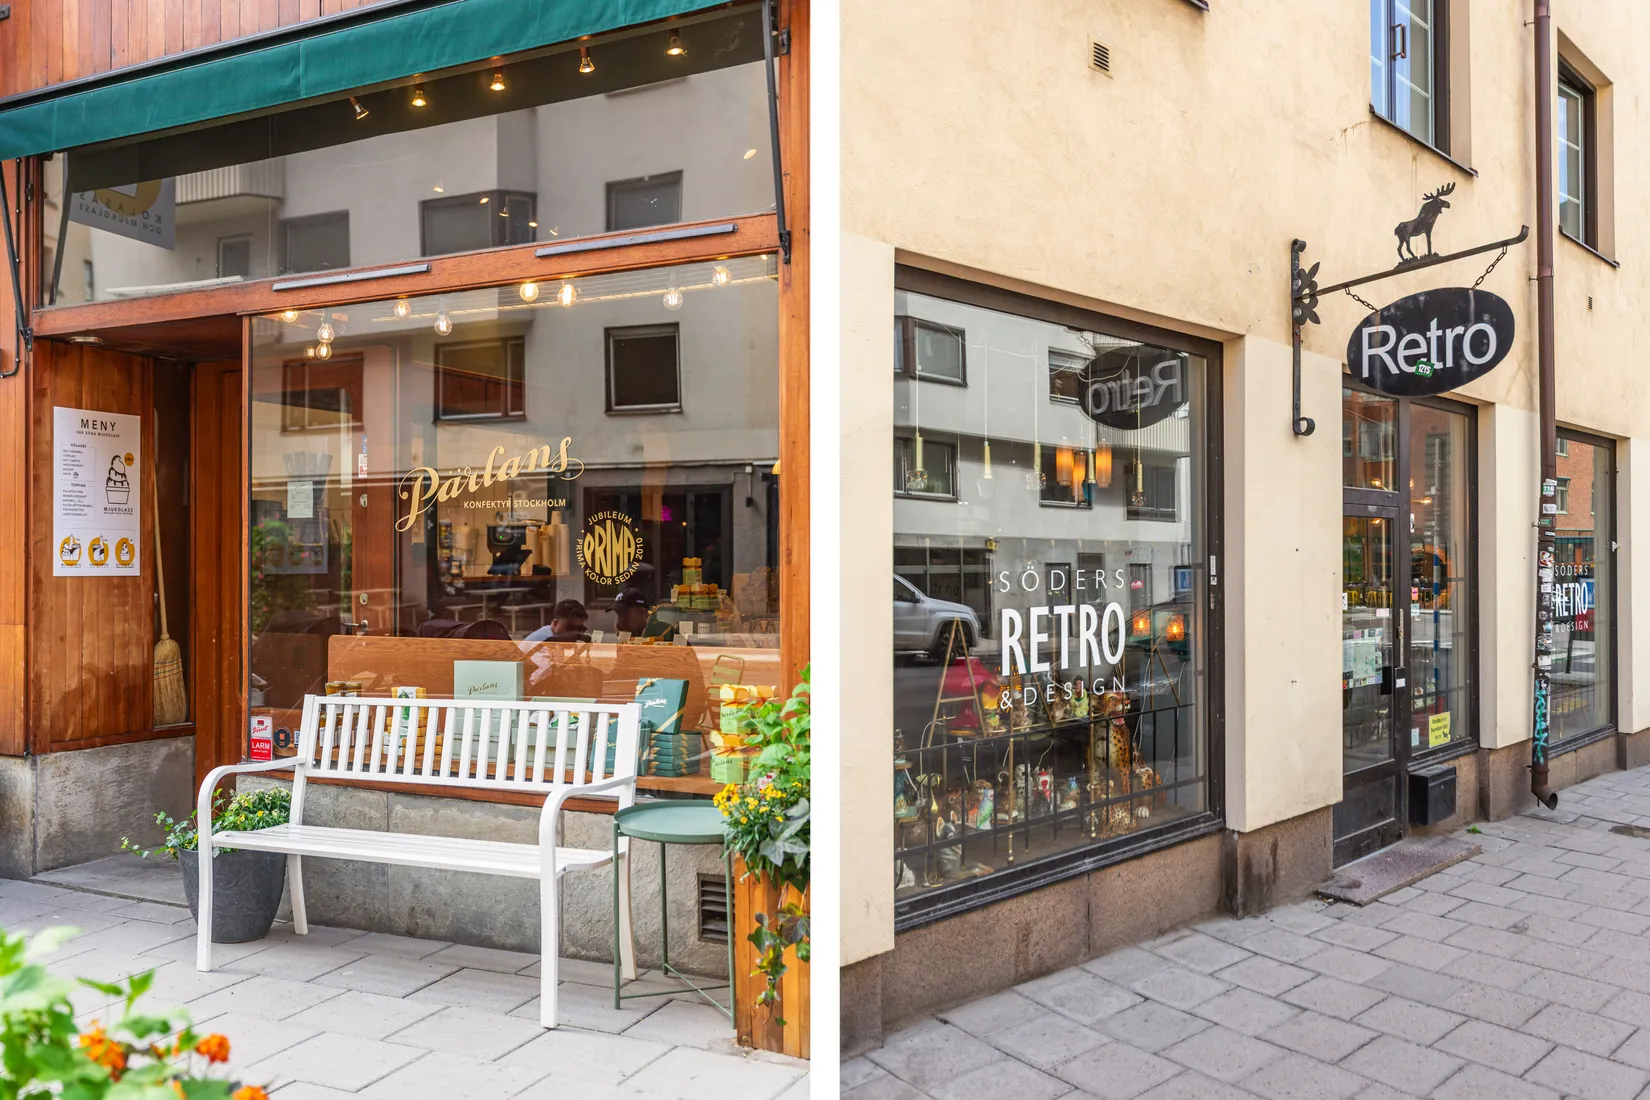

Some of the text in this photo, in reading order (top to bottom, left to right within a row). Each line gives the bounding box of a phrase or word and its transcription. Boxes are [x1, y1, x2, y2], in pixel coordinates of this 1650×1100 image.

[1361, 317, 1497, 379] Retro
[80, 418, 116, 432] MENY
[395, 436, 585, 532] Pärlans
[463, 498, 566, 509] KONFEKTYR STOCKHOLM
[588, 510, 632, 526] JUBILEUM
[575, 537, 644, 585] PRIMA KOLOR SEDAN 2010
[583, 519, 636, 577] PRIMA
[999, 564, 1125, 593] SÖDERS
[1554, 562, 1589, 576] SÖDERS
[1555, 581, 1589, 617] RETRO
[1001, 601, 1126, 677] RETRO
[1560, 620, 1589, 632] DESIGN
[1000, 675, 1125, 709] & DESIGN
[251, 741, 270, 750] LARM
